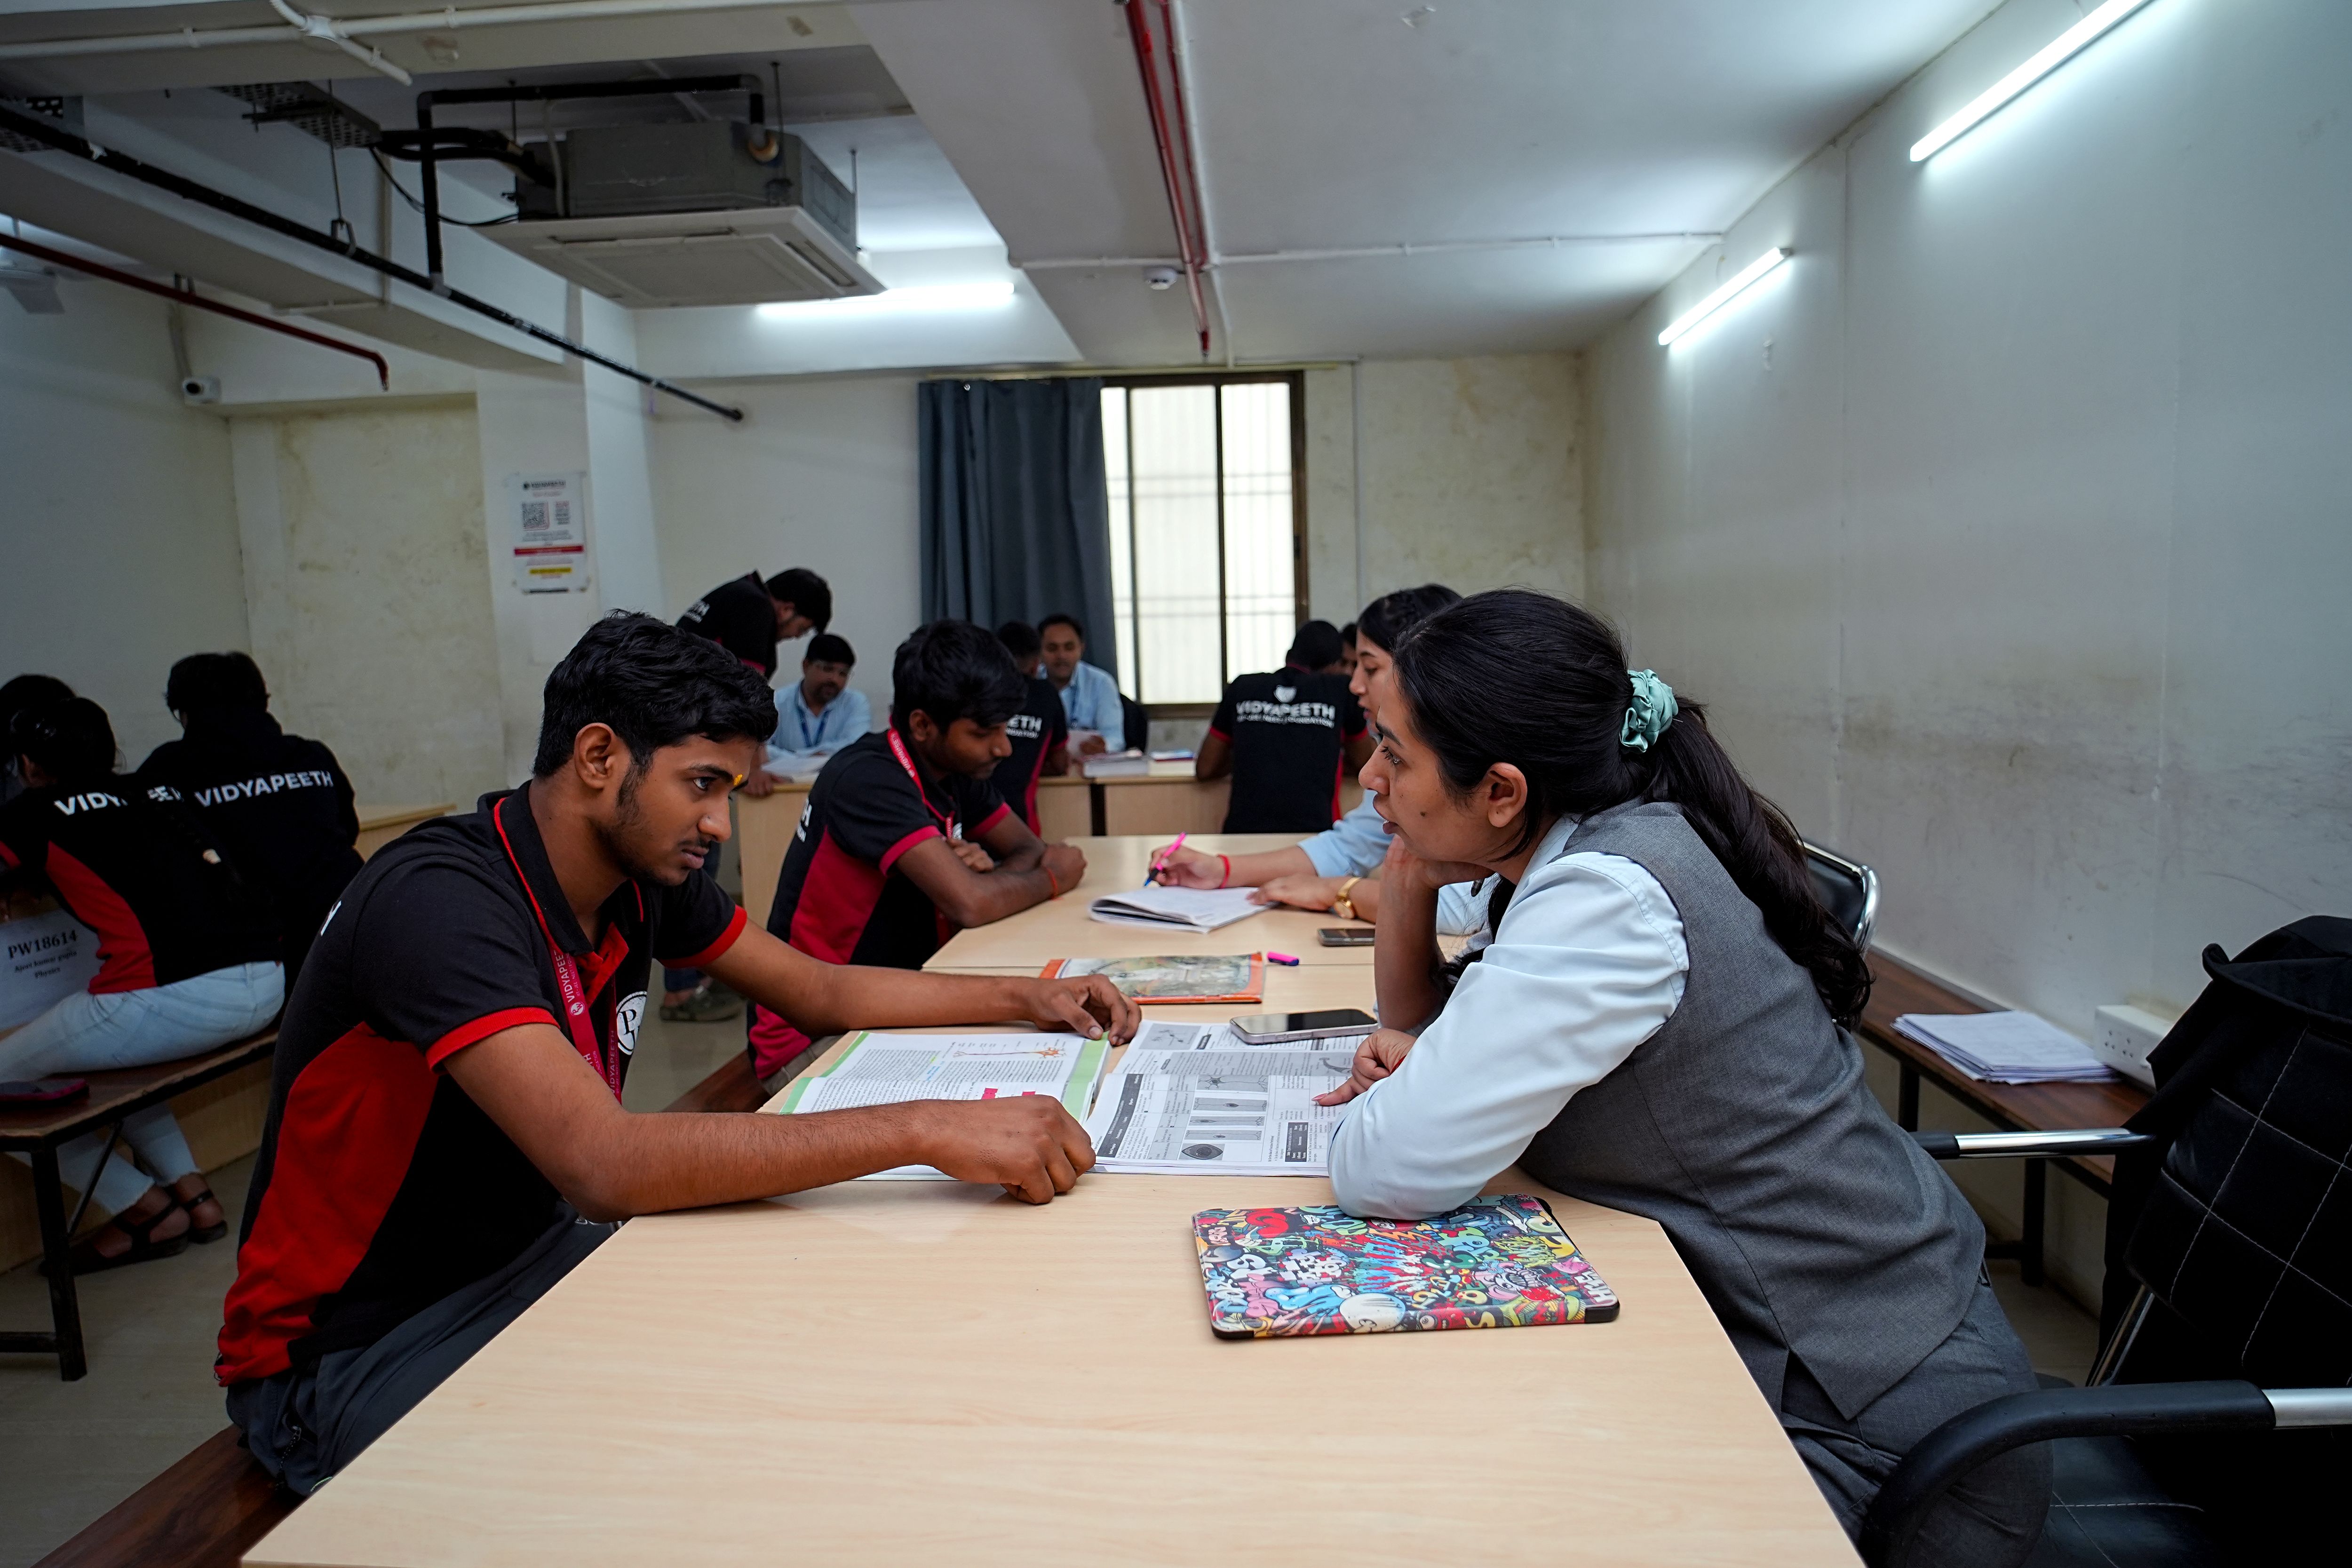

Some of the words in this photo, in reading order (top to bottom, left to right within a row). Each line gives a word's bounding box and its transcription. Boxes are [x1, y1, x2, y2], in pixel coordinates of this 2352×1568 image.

[1236, 700, 1336, 720] VIDYAPEETH
[194, 770, 334, 807] VIDYAPEETH
[53, 792, 128, 816] VIDY
[8, 930, 78, 959] PW18614
[554, 950, 575, 1003] VIDYAPEE
